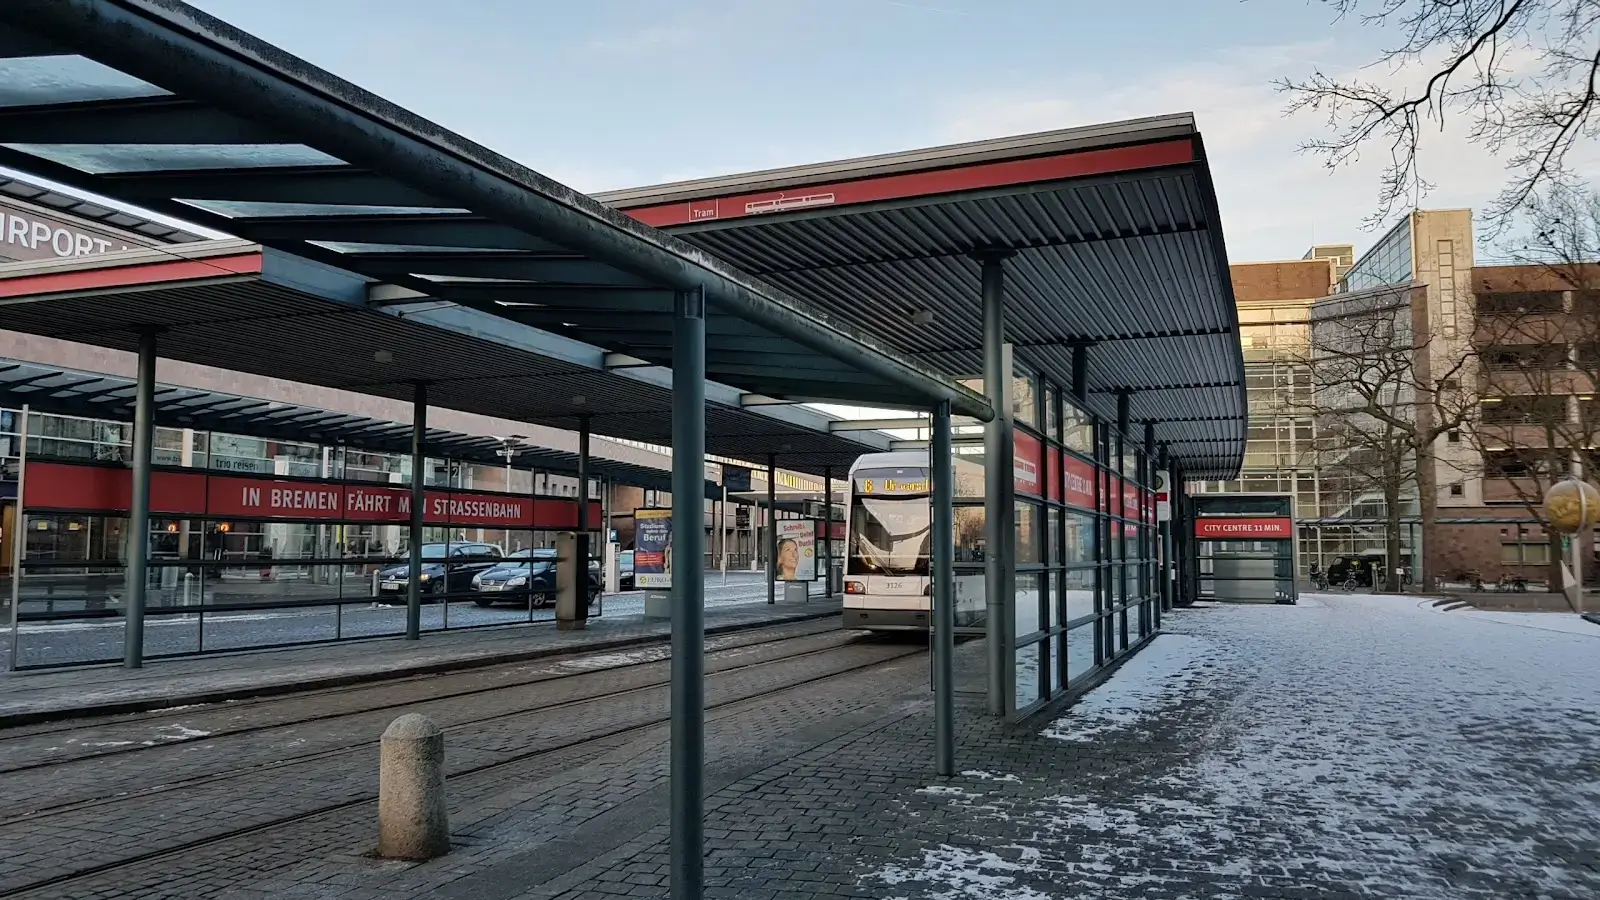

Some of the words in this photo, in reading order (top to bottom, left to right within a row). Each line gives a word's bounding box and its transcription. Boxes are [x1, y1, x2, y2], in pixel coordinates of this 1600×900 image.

[693, 209, 714, 218] Tram
[0, 212, 112, 257] IRPORT
[215, 457, 231, 469] trio
[233, 460, 258, 471] reisen
[242, 486, 261, 506] IN
[271, 488, 338, 510] BREMEN
[347, 490, 391, 512] FÄHRT
[398, 495, 427, 514] MN
[433, 499, 521, 519] STRASSENBAHN
[1204, 524, 1221, 532] CITY
[1222, 524, 1252, 532] CENTRE
[1254, 524, 1262, 532] 11
[1264, 524, 1282, 532] MIN.
[643, 533, 666, 542] Beruf
